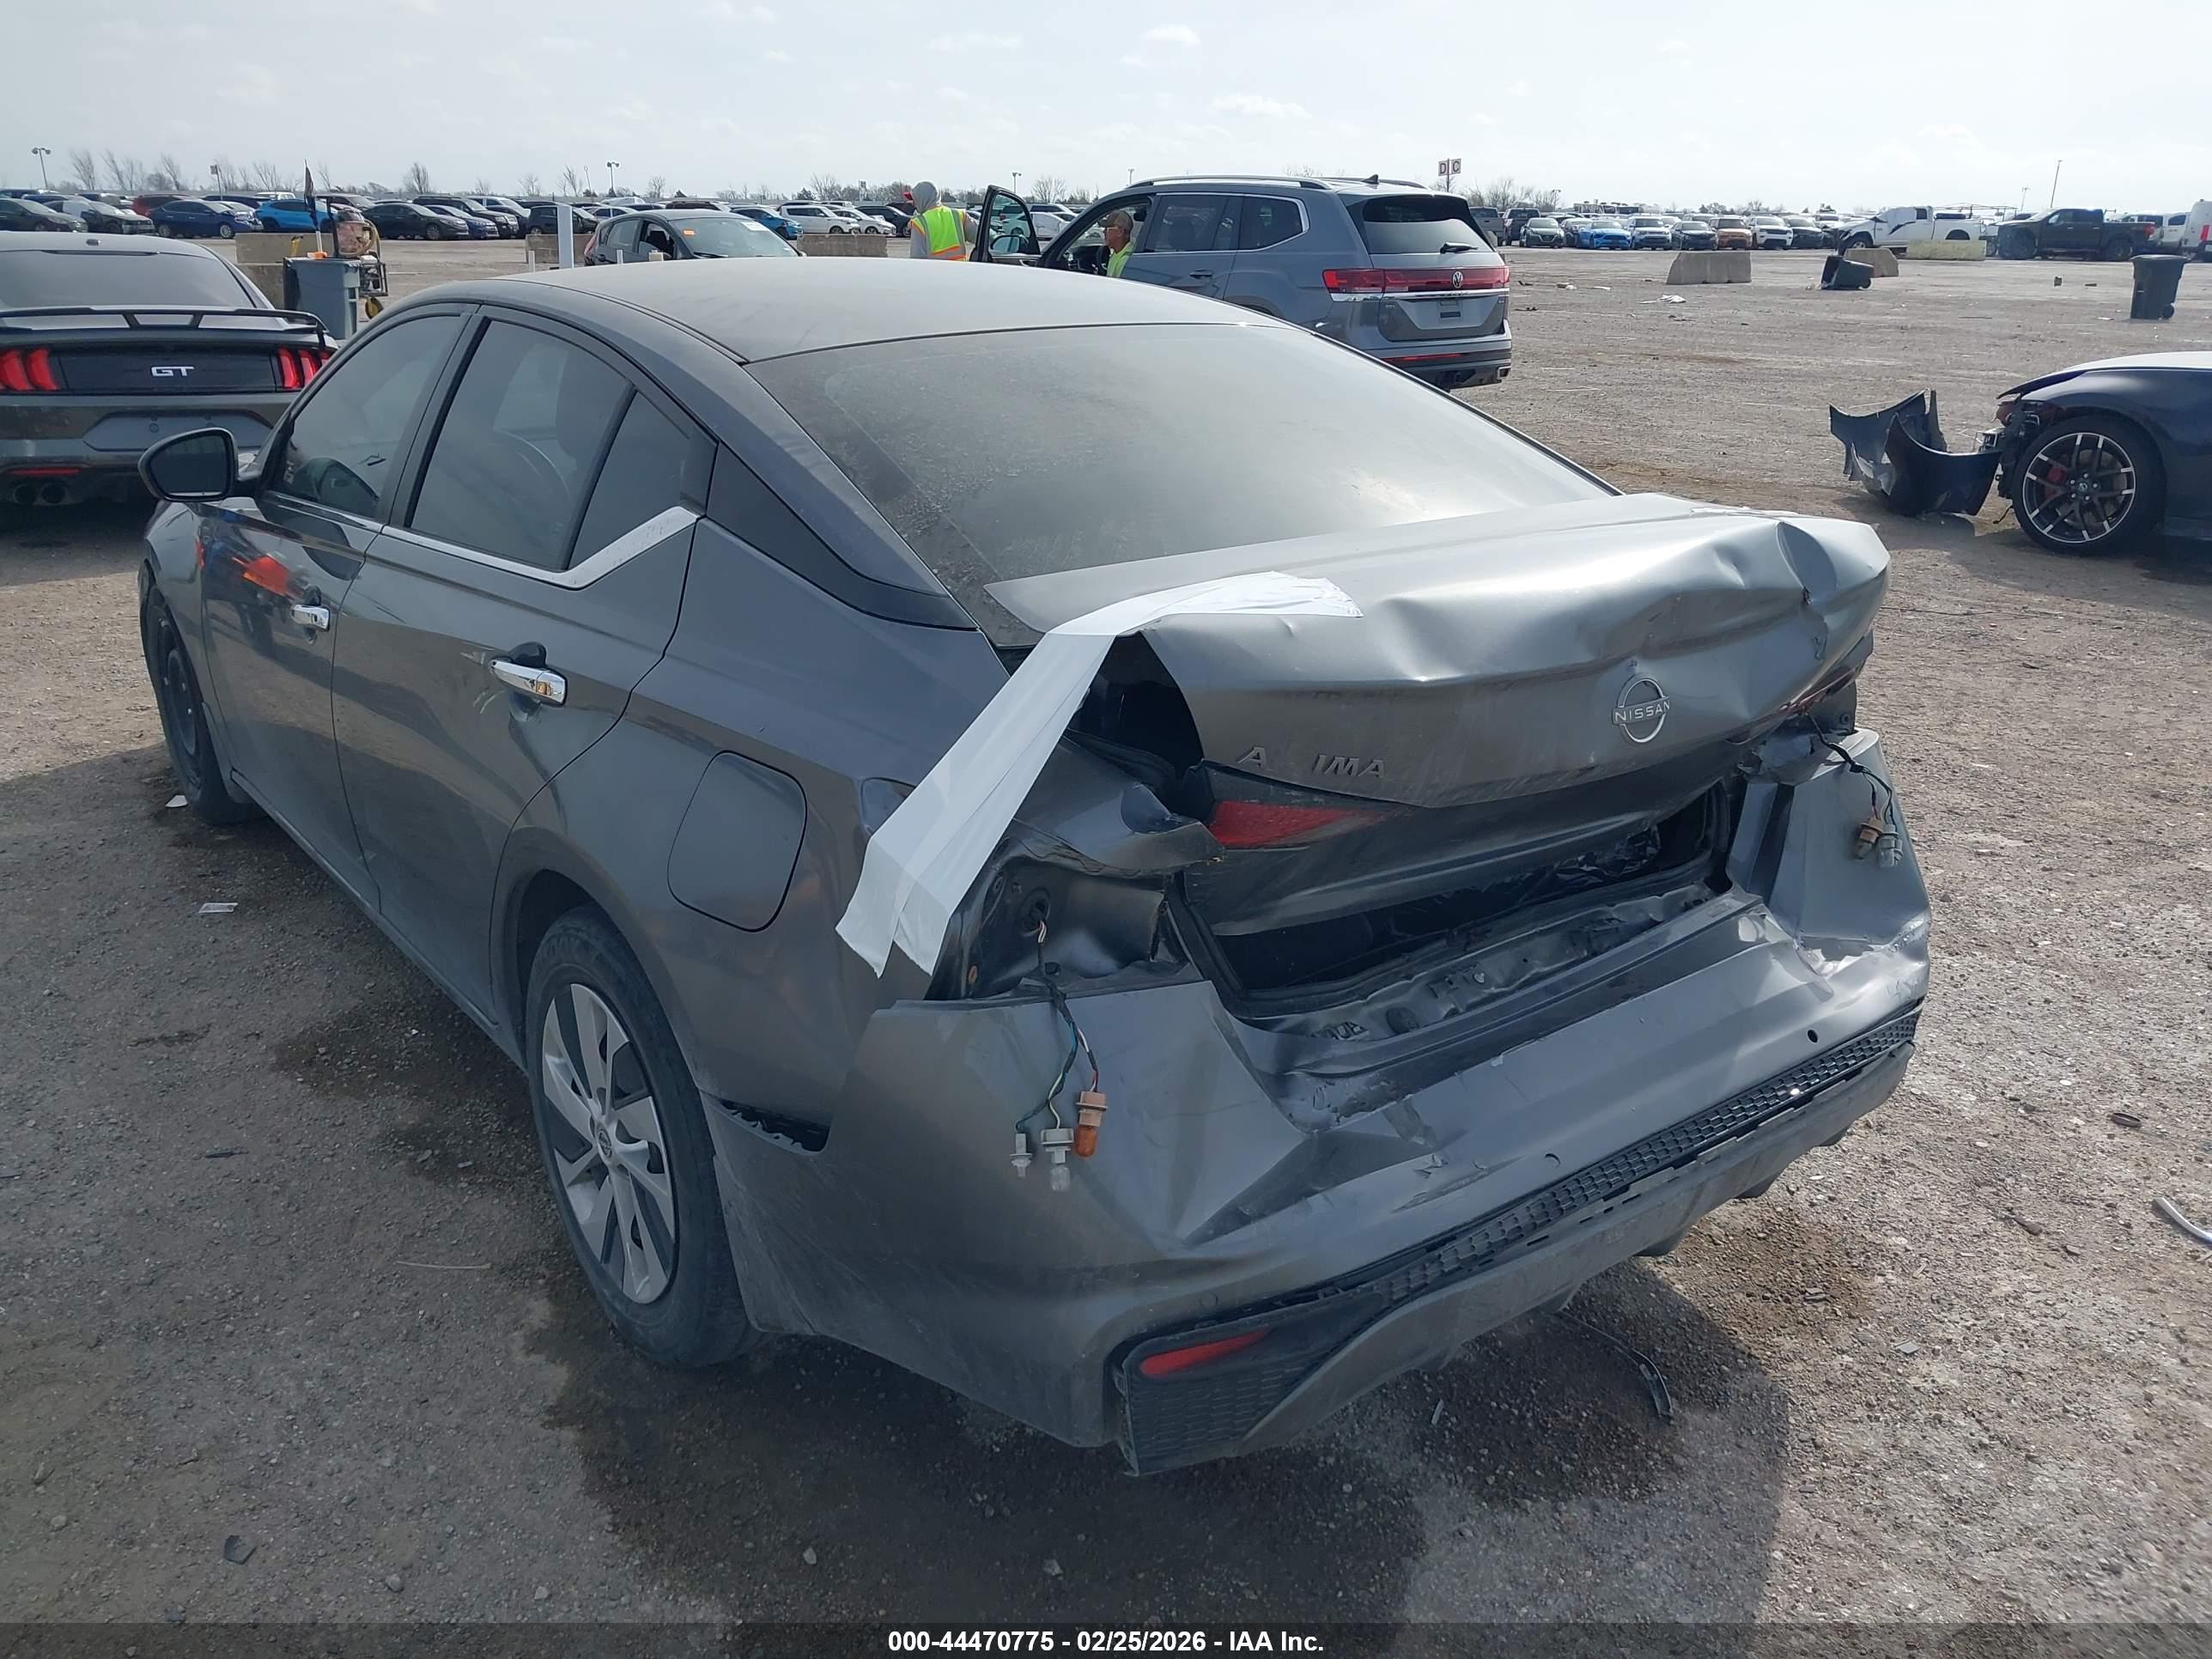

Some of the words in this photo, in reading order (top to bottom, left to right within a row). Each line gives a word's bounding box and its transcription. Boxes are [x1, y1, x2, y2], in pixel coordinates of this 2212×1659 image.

[1439, 162, 1446, 174] D
[1452, 161, 1460, 173] C
[151, 366, 195, 377] GT
[1614, 700, 1670, 722] NISSAN
